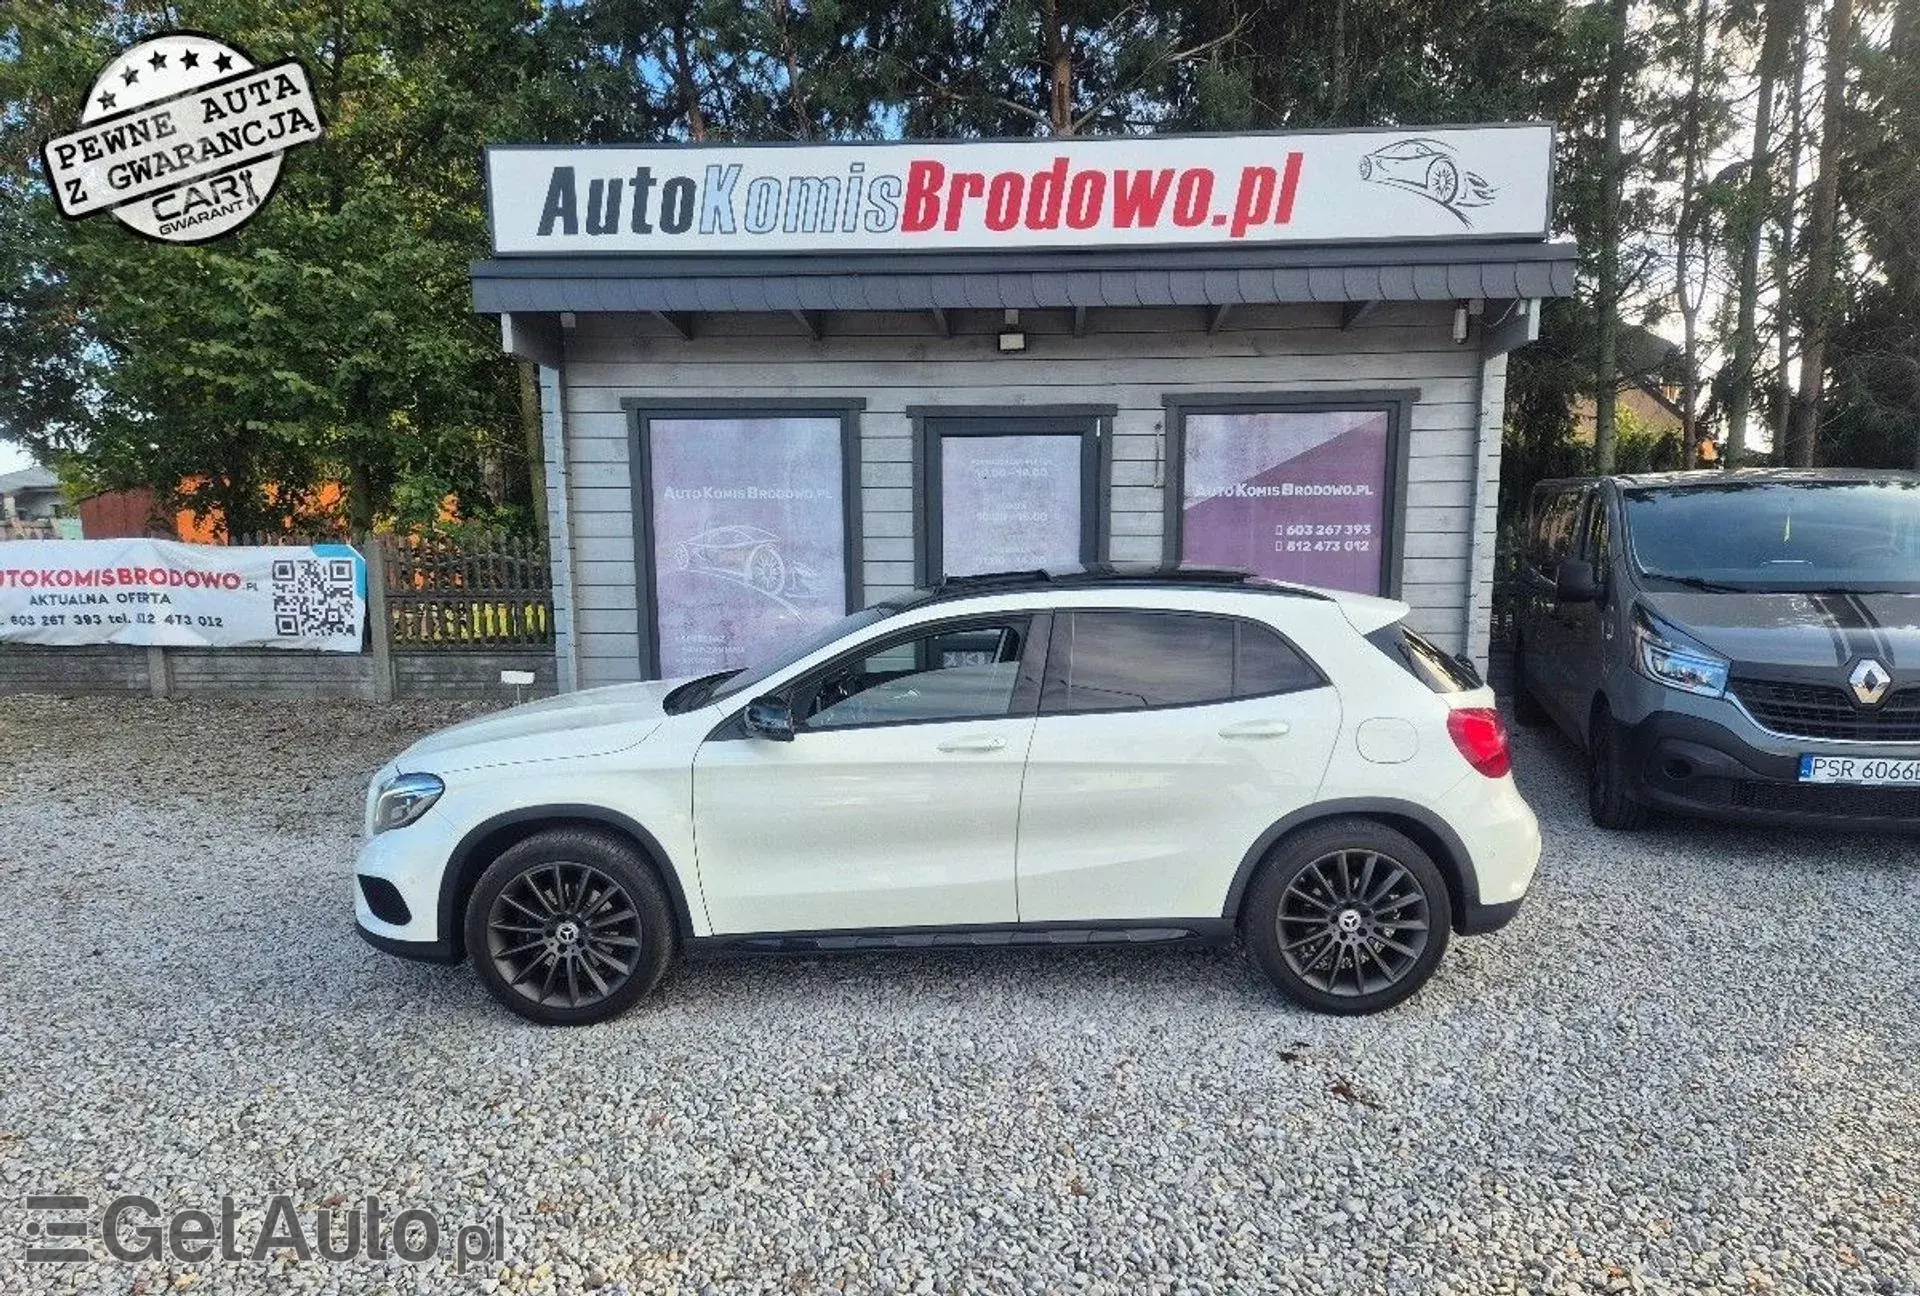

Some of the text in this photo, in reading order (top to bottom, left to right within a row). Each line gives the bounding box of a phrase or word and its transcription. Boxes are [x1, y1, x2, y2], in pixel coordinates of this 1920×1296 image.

[537, 151, 1304, 237] AutoKomisBrodowo.pl
[1286, 524, 1371, 536] 603 267 393
[1314, 540, 1340, 552] 473
[1344, 540, 1369, 552] 012
[30, 592, 172, 606] AKTUALNA OFERTA
[10, 614, 36, 626] 603
[41, 614, 66, 626] 267
[73, 614, 102, 625] 393
[164, 614, 193, 626] 473
[198, 615, 224, 627] 012
[1813, 758, 1855, 778] PSR
